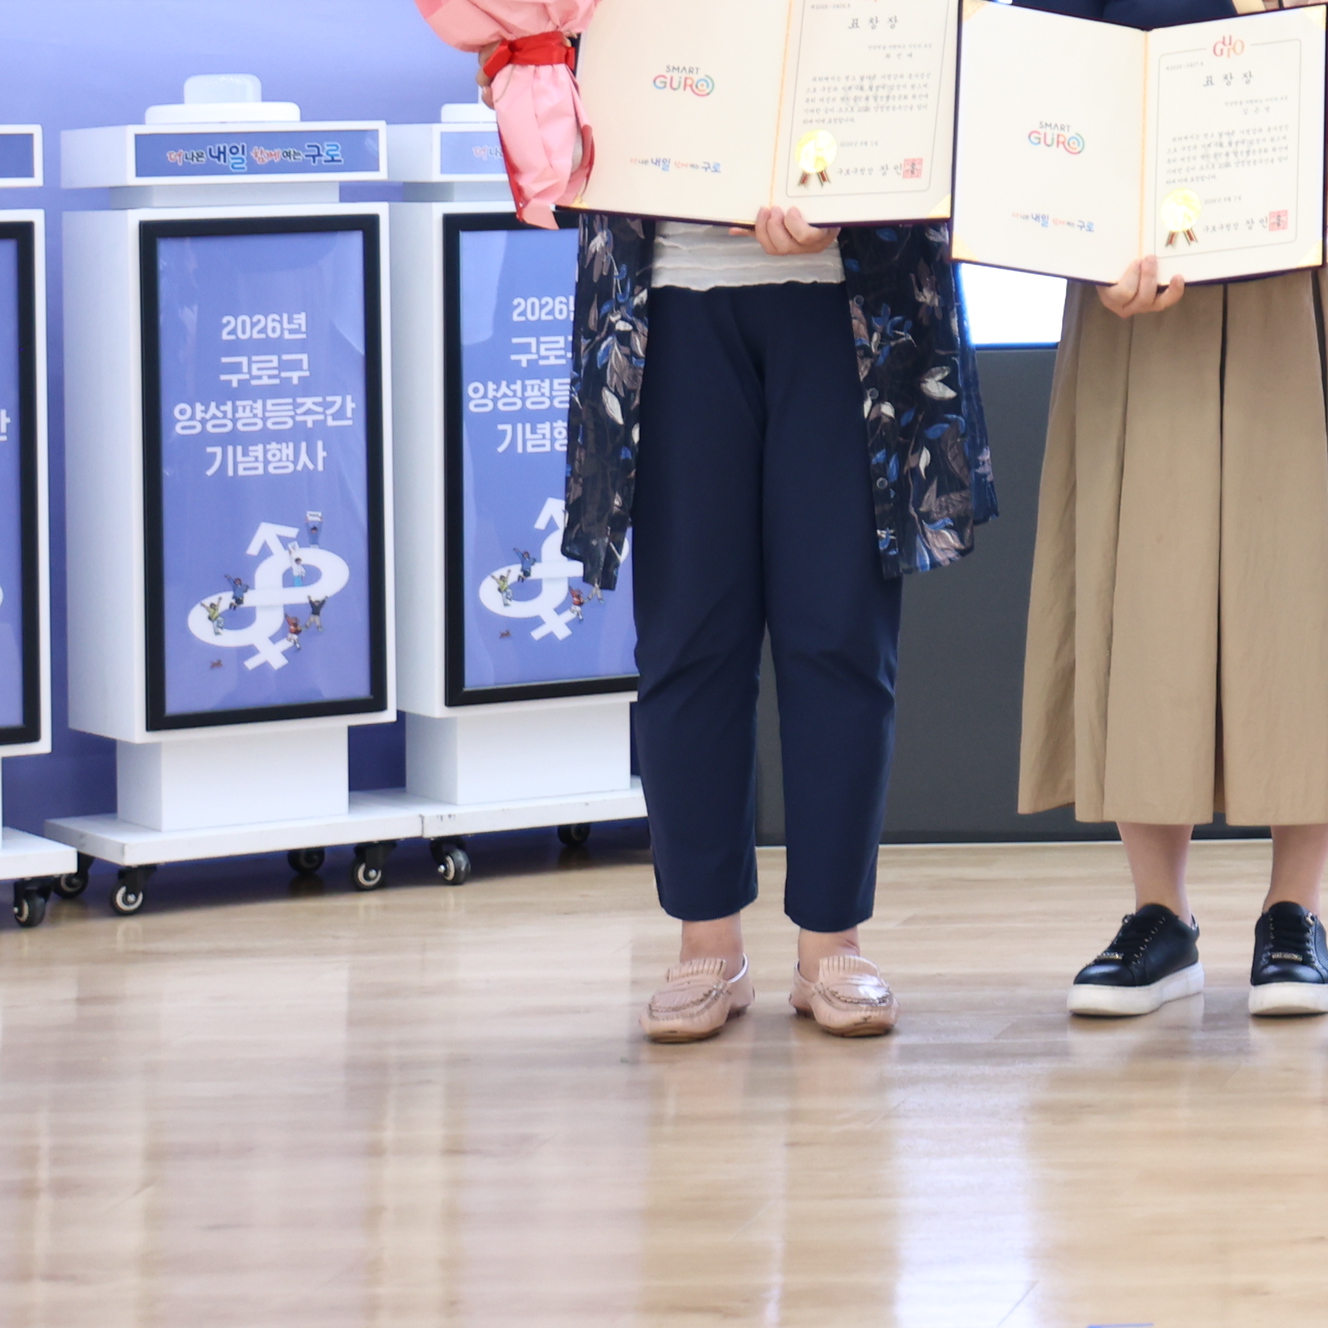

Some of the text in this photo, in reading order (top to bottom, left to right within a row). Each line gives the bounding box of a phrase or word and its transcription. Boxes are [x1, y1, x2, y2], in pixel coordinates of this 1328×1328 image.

[665, 64, 700, 75] SMART
[1039, 121, 1071, 132] SMART
[168, 150, 183, 165] 더
[185, 150, 206, 164] 나은
[208, 142, 246, 171] 내일
[282, 149, 303, 162] 여는
[304, 142, 343, 165] 구로
[221, 311, 307, 341] 2026년
[510, 335, 573, 368] 구로
[219, 353, 310, 388] 구로구
[173, 394, 356, 436] 양성평등주간
[205, 440, 327, 477] 기념행사
